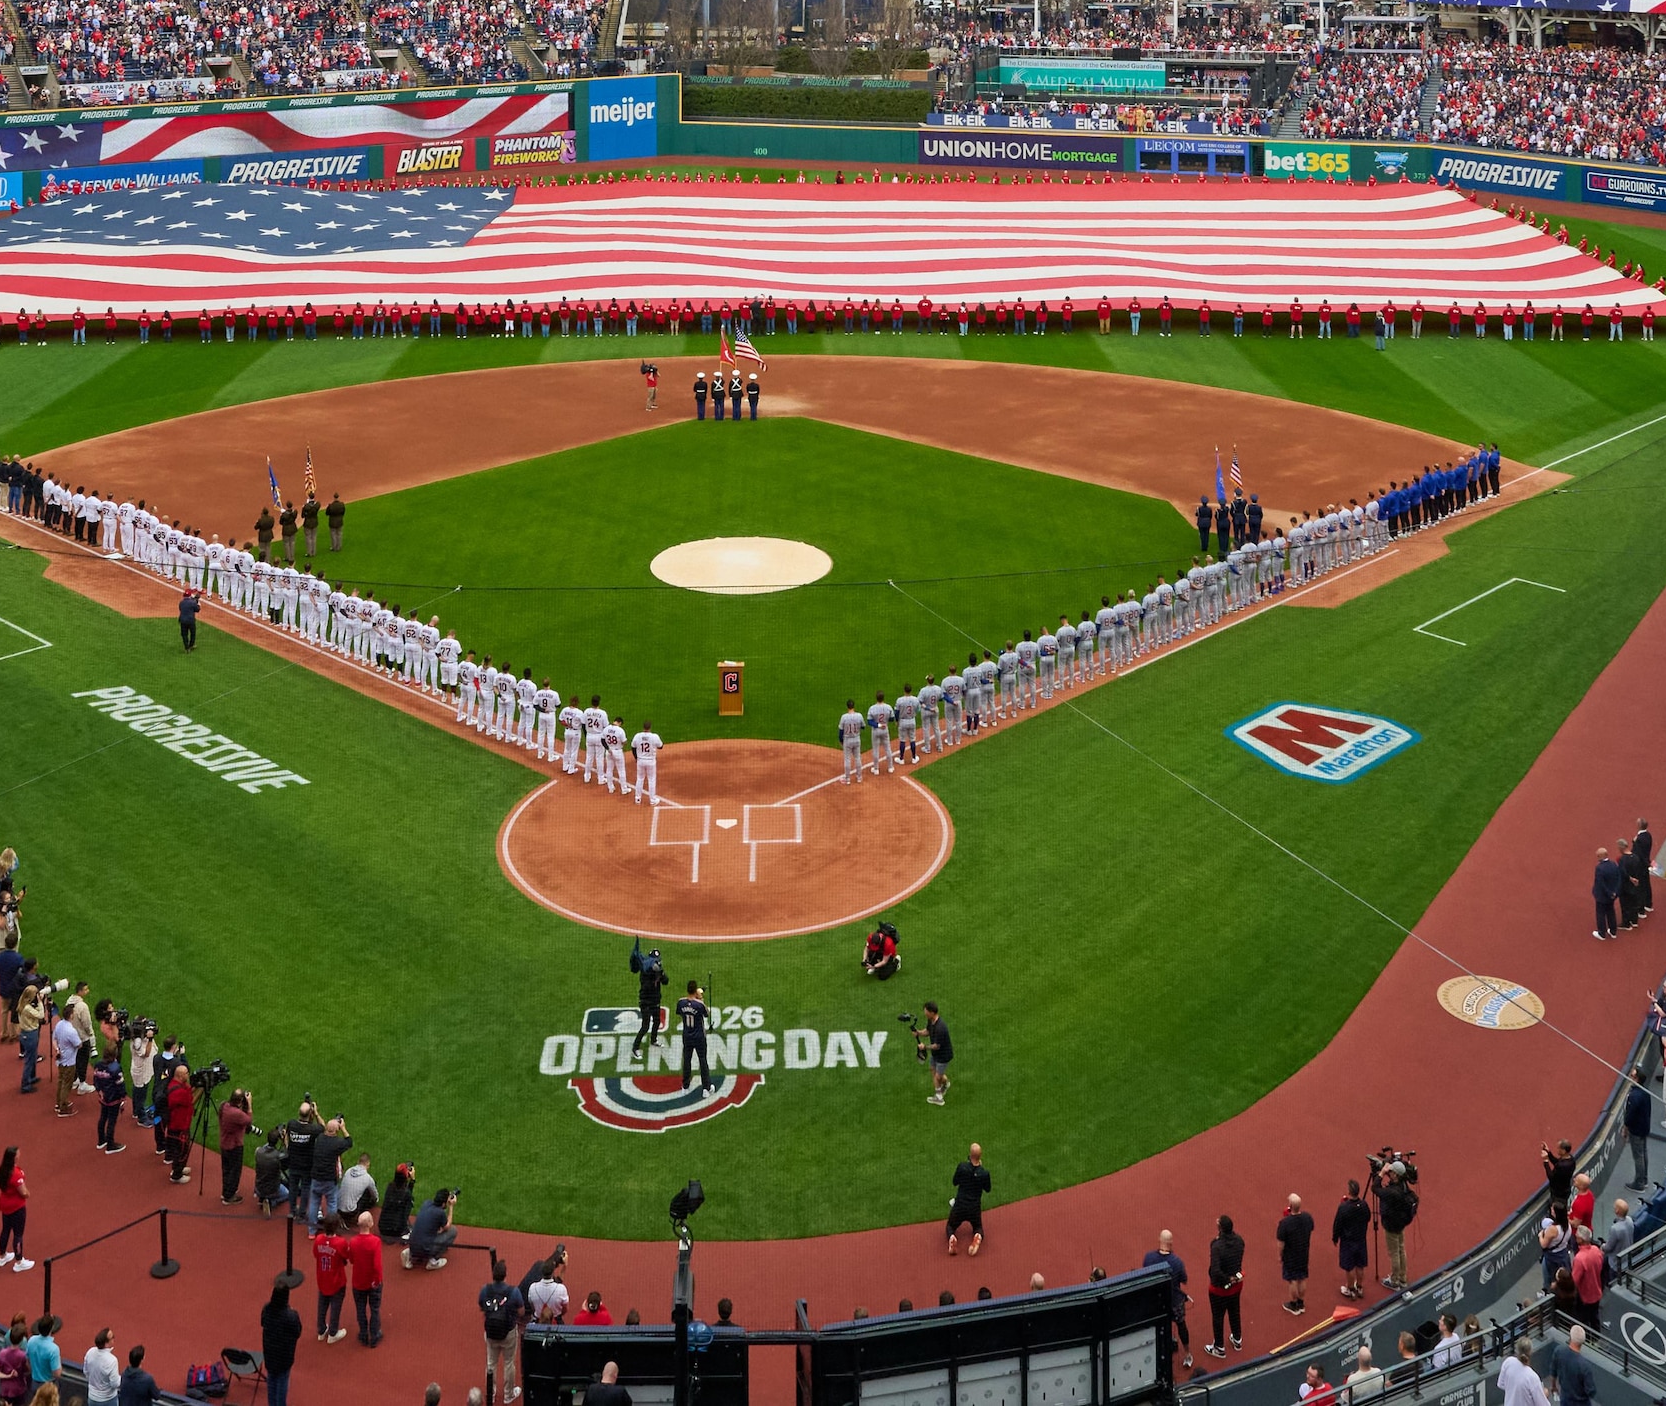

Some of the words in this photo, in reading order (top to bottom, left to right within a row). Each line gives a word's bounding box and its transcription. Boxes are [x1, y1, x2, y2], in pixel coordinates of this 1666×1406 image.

[1017, 60, 1039, 68] Official
[1060, 61, 1080, 69] Insurer
[1100, 62, 1132, 70] Cleveland
[1133, 63, 1163, 71] Guardians
[534, 83, 574, 92] PROGRESSIVE
[743, 77, 792, 87] PROGRESSIVE
[801, 78, 851, 88] PROGRESSIVE
[861, 79, 911, 89] PROGRESSIVE
[1036, 75, 1089, 88] MEDICAL
[1100, 76, 1157, 90] MUTUAL
[416, 89, 459, 99] PROGRESSIVE
[476, 85, 518, 96] PROGRESSIVE
[288, 97, 334, 107] PROGRESSIVE
[353, 93, 397, 103] PROGRESSIVE
[151, 105, 201, 115] PROGRESSIVE
[221, 100, 269, 112] PROGRESSIVE
[590, 96, 656, 127] meijer
[4, 113, 58, 124] PROGRESSIVE
[79, 109, 131, 120] PROGRESSIVE
[494, 135, 562, 153] PHANTOM
[753, 147, 768, 156] 400
[1052, 150, 1118, 163] MORTGAGE
[396, 145, 464, 175] BLASTER
[493, 149, 561, 166] FIREWORKS
[1265, 149, 1350, 173] bet365
[227, 154, 365, 183] PROGRESSIVE
[1437, 157, 1560, 191] PROGRESSIVE
[1413, 172, 1427, 180] 375
[498, 682, 507, 692] 10
[542, 698, 548, 708] 9
[587, 718, 600, 728] 24
[72, 685, 311, 795] PROGRESSIVE
[606, 734, 618, 745] 38
[640, 742, 651, 753] 12
[1314, 727, 1403, 778] Marathon
[783, 1028, 888, 1069] DAY
[1453, 1276, 1465, 1302] 2
[1440, 1384, 1474, 1406] CARNEGIE
